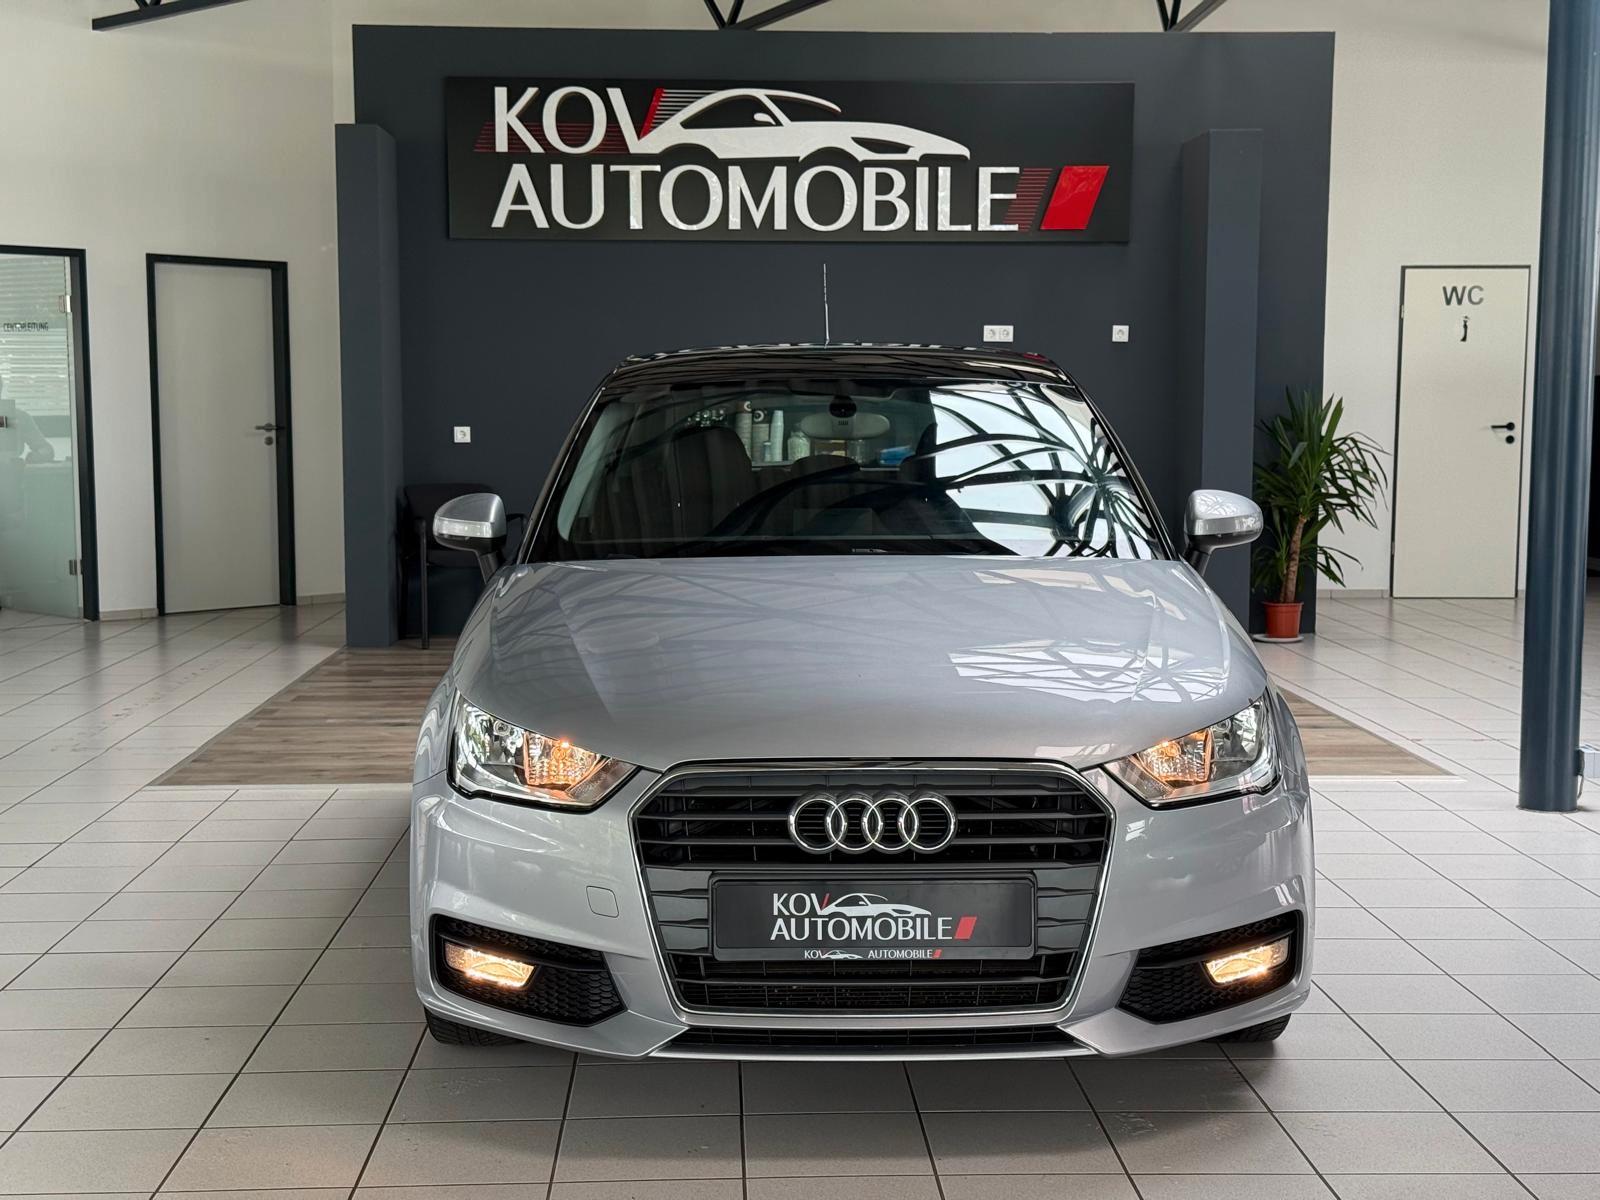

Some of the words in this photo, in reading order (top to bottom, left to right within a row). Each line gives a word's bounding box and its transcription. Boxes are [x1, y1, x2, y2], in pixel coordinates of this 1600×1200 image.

[493, 86, 665, 154] KOV
[491, 164, 1020, 232] AUTOMOBILE
[1442, 285, 1484, 306] WC
[773, 892, 829, 916] KOV
[770, 917, 953, 941] AUTOMOBILE
[867, 949, 933, 959] AUTOMOBILE
